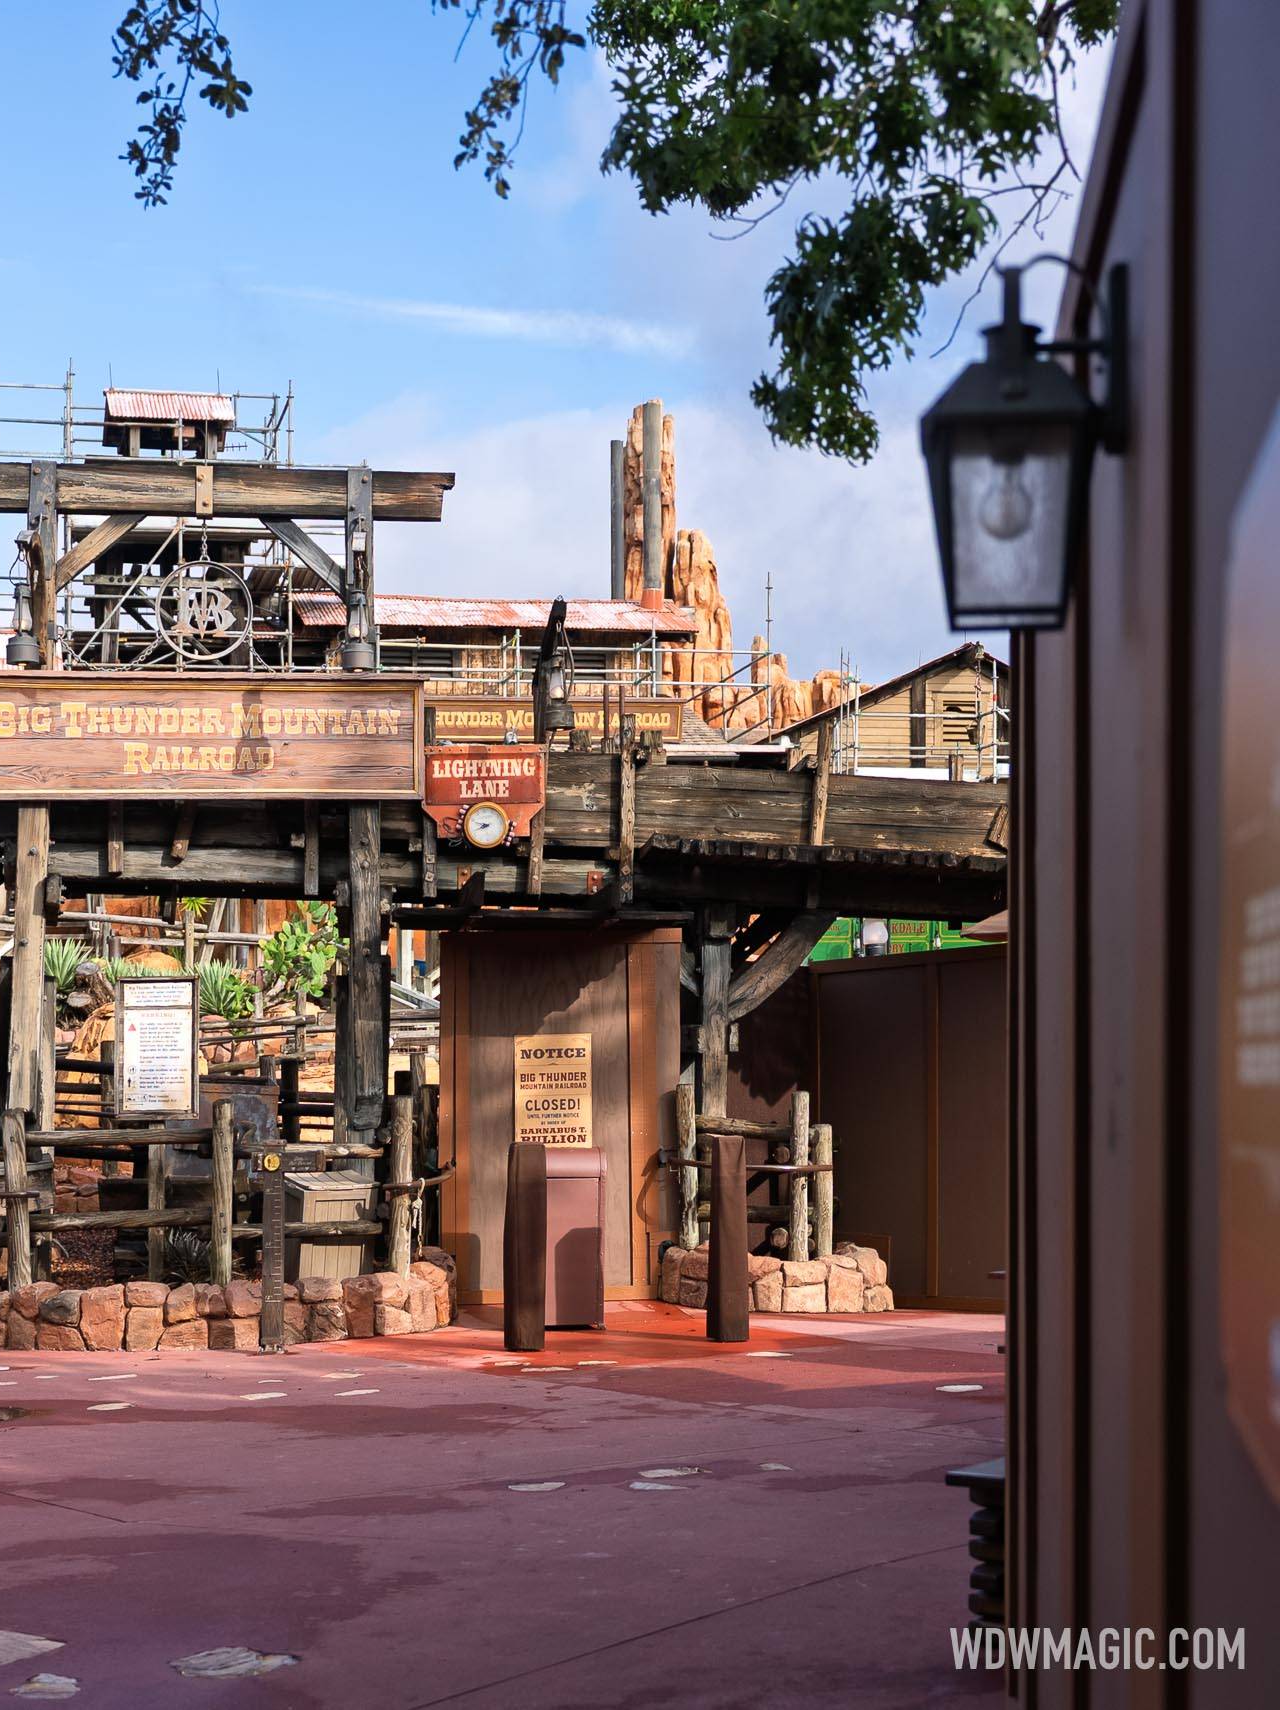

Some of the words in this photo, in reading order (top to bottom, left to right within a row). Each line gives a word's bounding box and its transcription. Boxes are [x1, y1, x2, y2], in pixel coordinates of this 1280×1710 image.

[61, 702, 226, 737] THUNDER
[231, 703, 401, 738] MOUNTAIN
[436, 711, 503, 728] HUNDER
[506, 709, 596, 729] MOAIN
[124, 742, 275, 775] RAILROAD
[432, 758, 536, 778] LIGHTNING
[459, 780, 510, 798] LANE
[520, 1048, 586, 1059] NOTICE
[520, 1073, 536, 1083] BIG
[539, 1071, 587, 1081] THUNDER
[525, 1099, 581, 1112] CLOSED!
